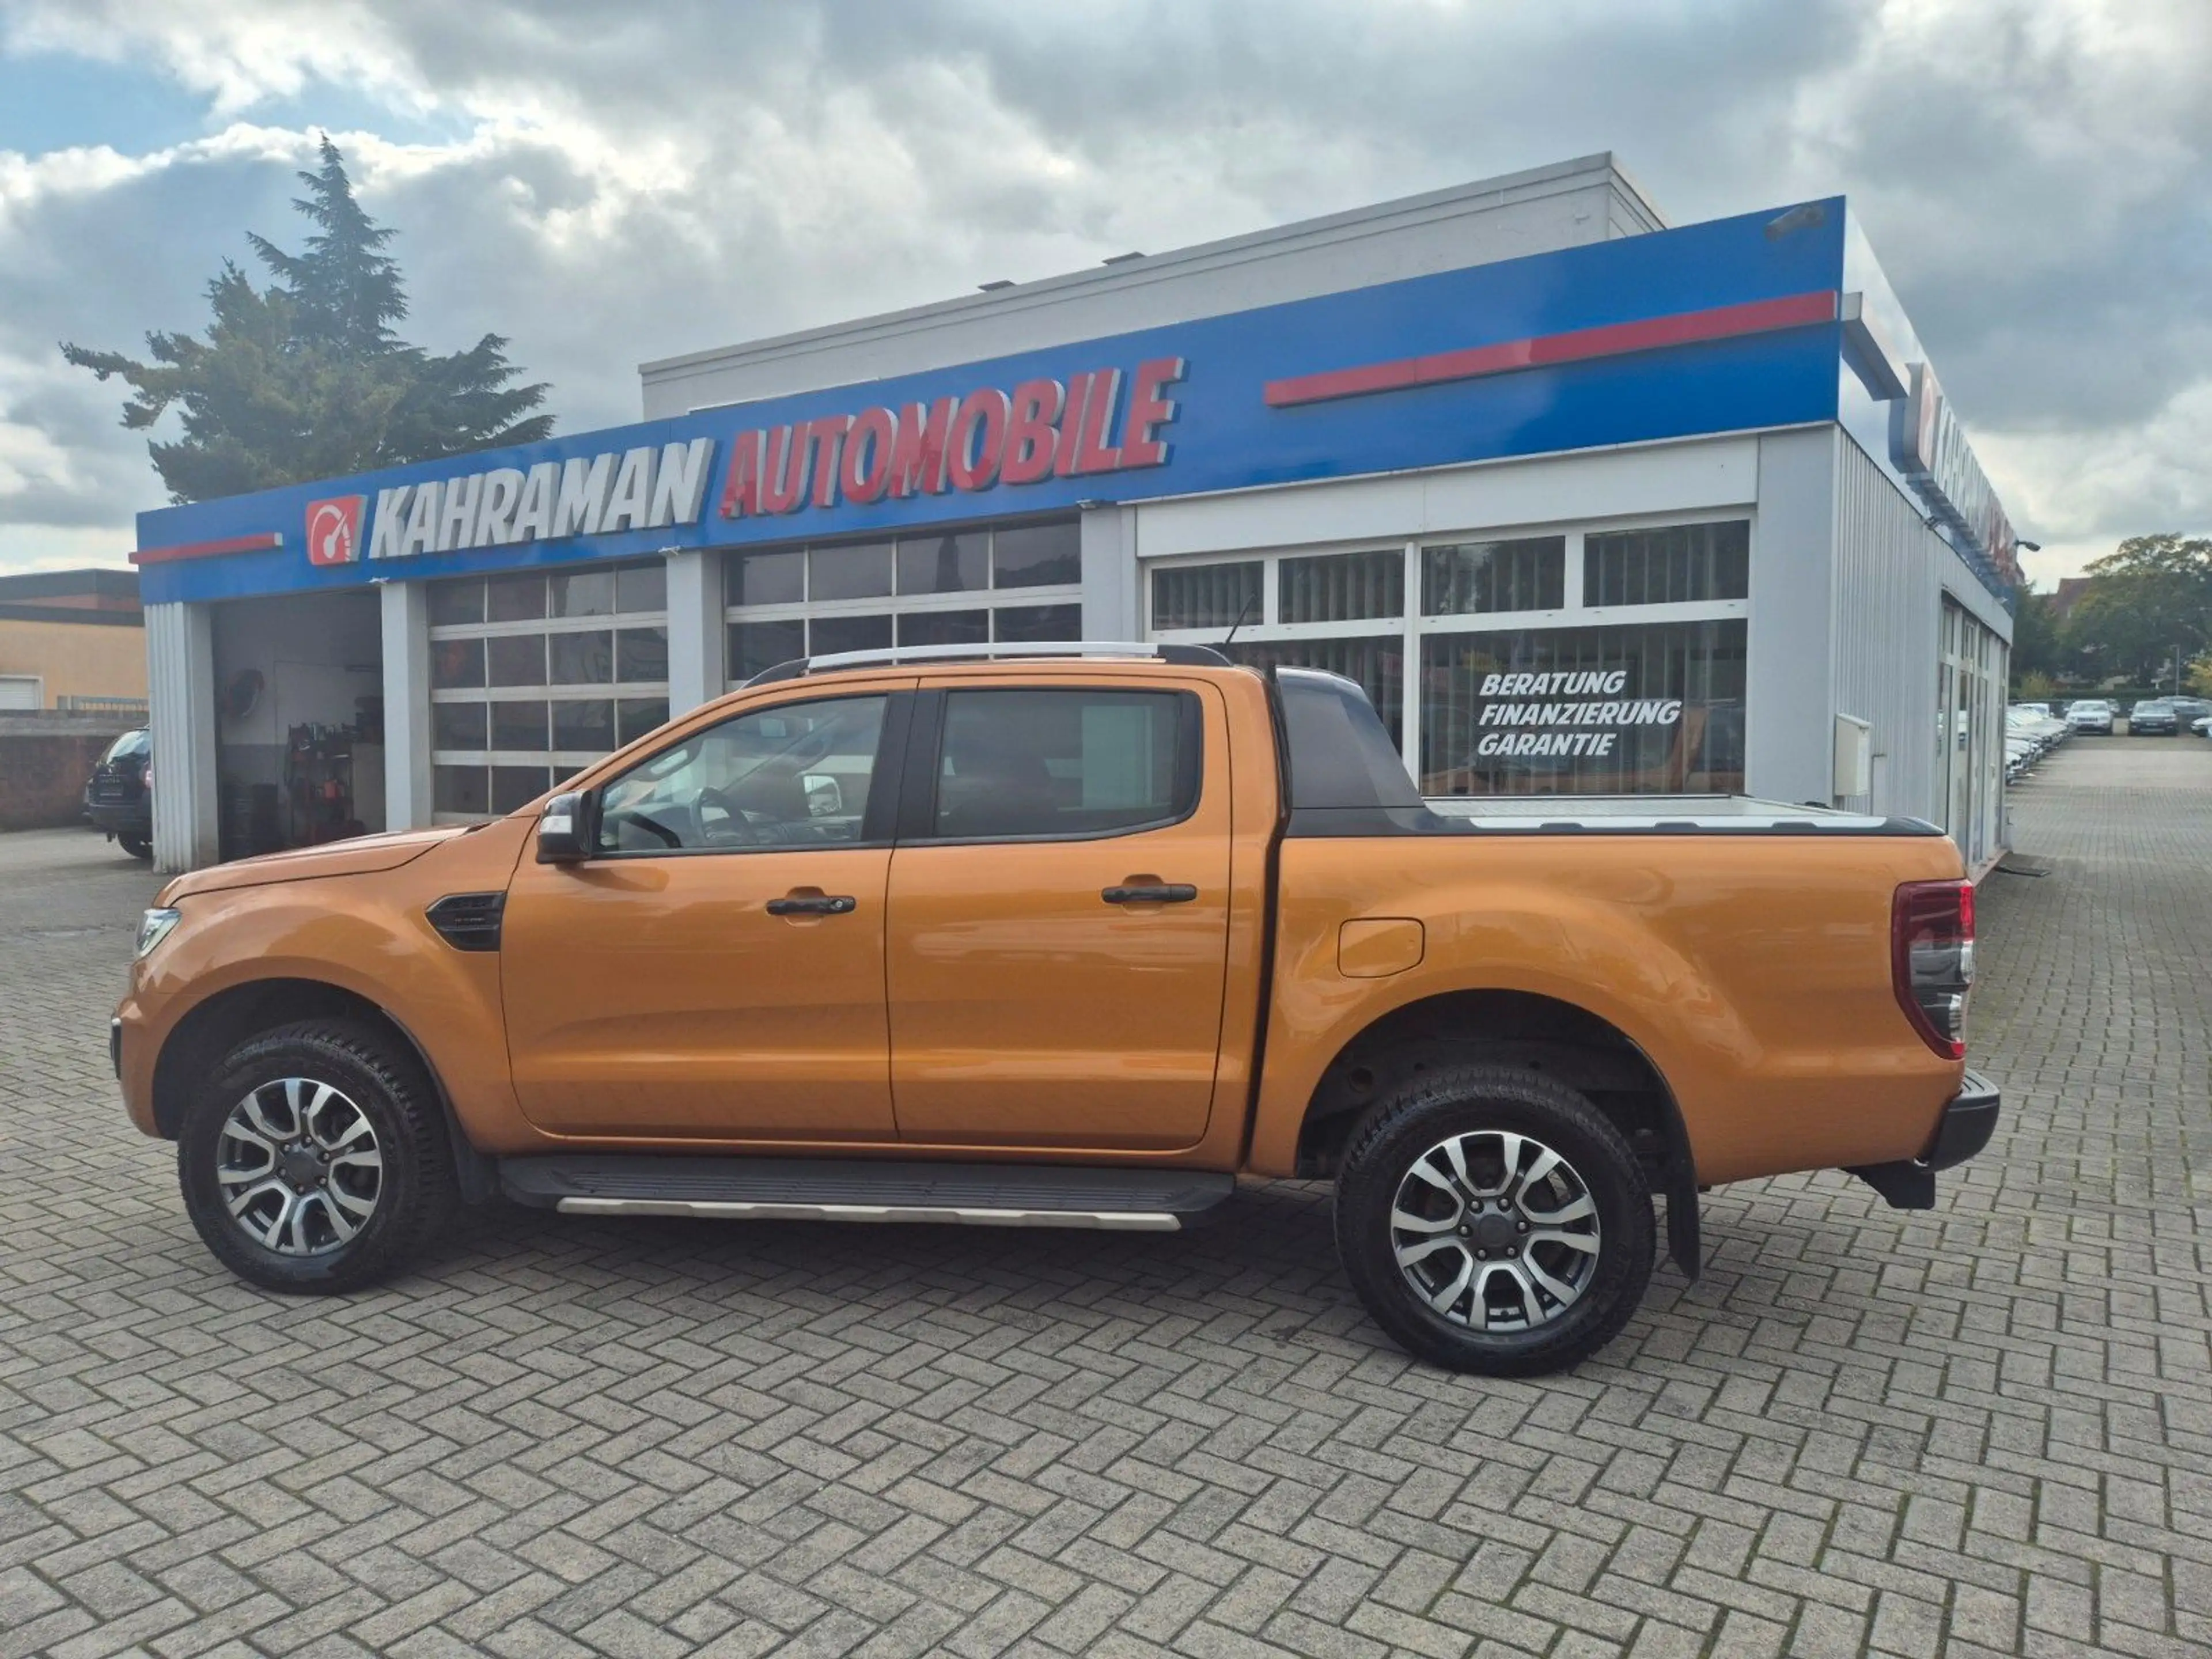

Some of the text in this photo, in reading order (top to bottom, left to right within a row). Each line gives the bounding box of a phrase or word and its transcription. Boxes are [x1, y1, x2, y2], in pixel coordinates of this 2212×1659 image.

[368, 357, 1185, 559] KAHRAMAN AUTOMOBILE
[1479, 671, 1626, 696] BERATUNG
[1479, 701, 1681, 725] FINANZIERUNG
[1478, 733, 1616, 756] GARANTIE
